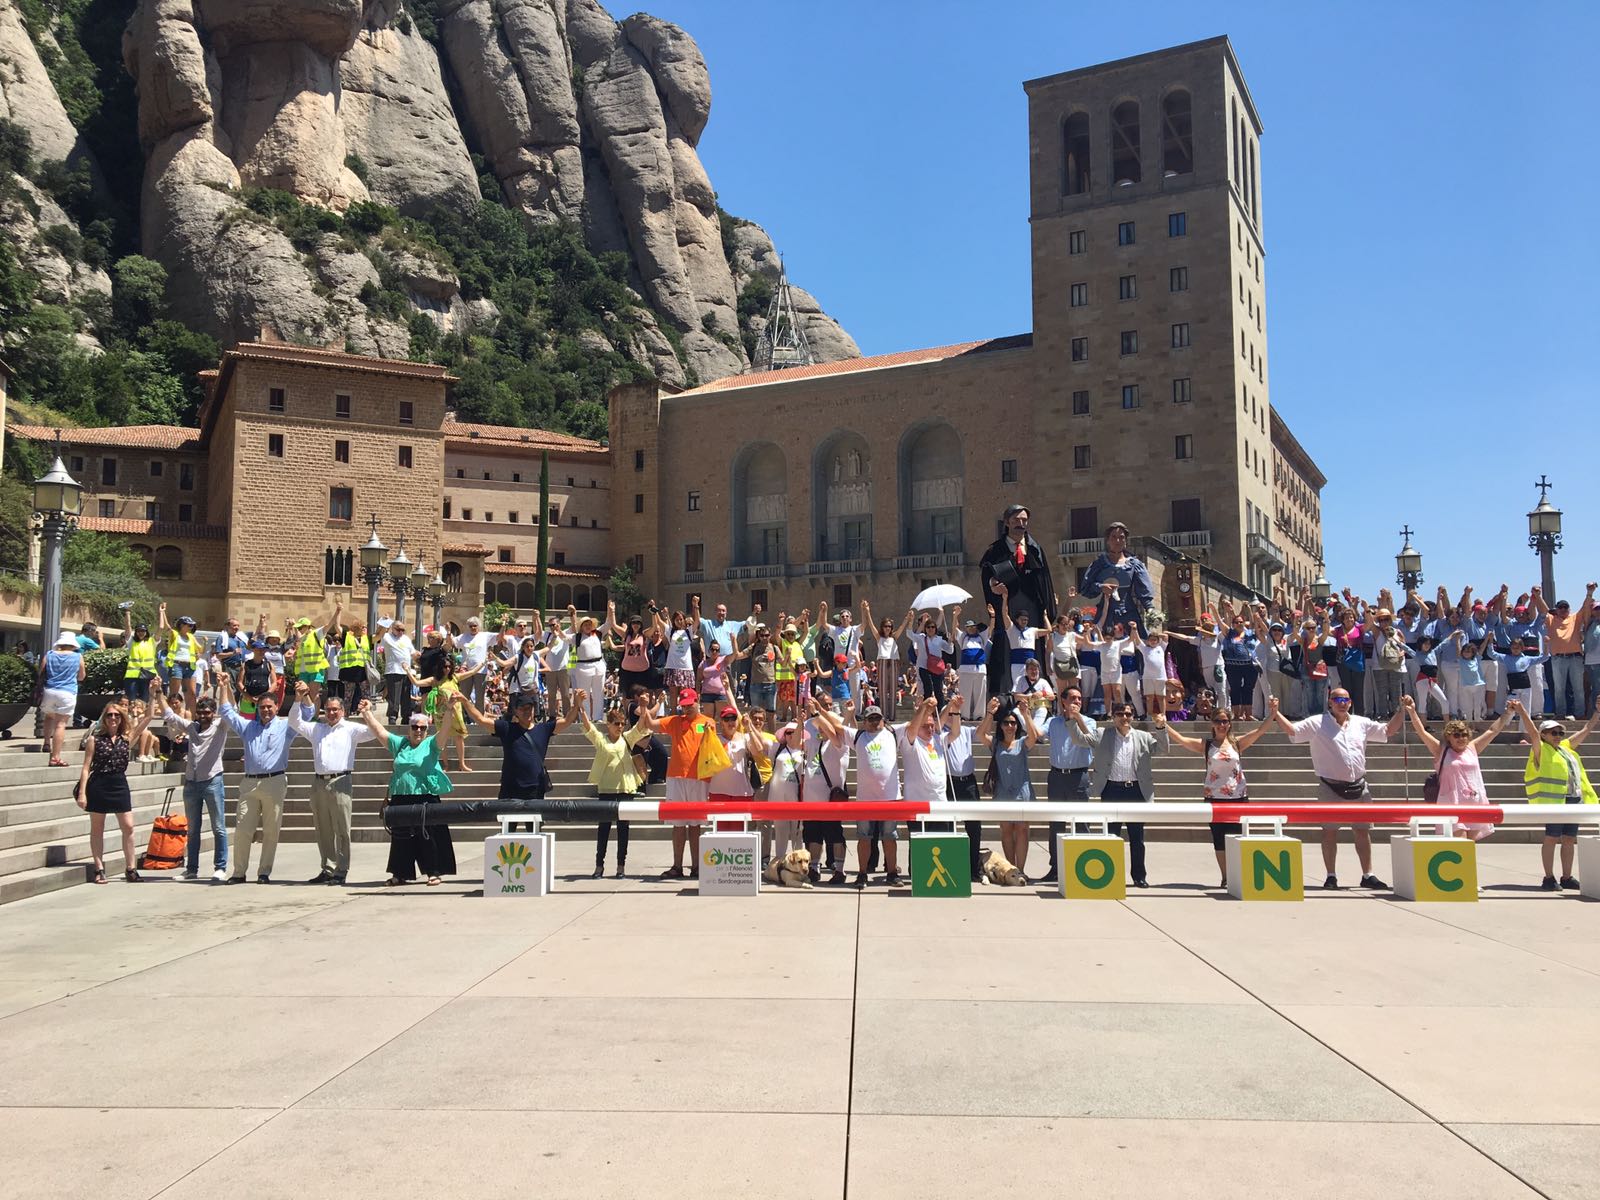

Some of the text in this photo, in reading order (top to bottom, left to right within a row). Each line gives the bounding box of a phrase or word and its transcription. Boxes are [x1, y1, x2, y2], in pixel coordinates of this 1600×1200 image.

[703, 848, 753, 866] ONCE
[1075, 849, 1115, 890] O
[1253, 850, 1292, 891] N
[1428, 850, 1464, 892] C
[501, 884, 526, 893] ANYS
